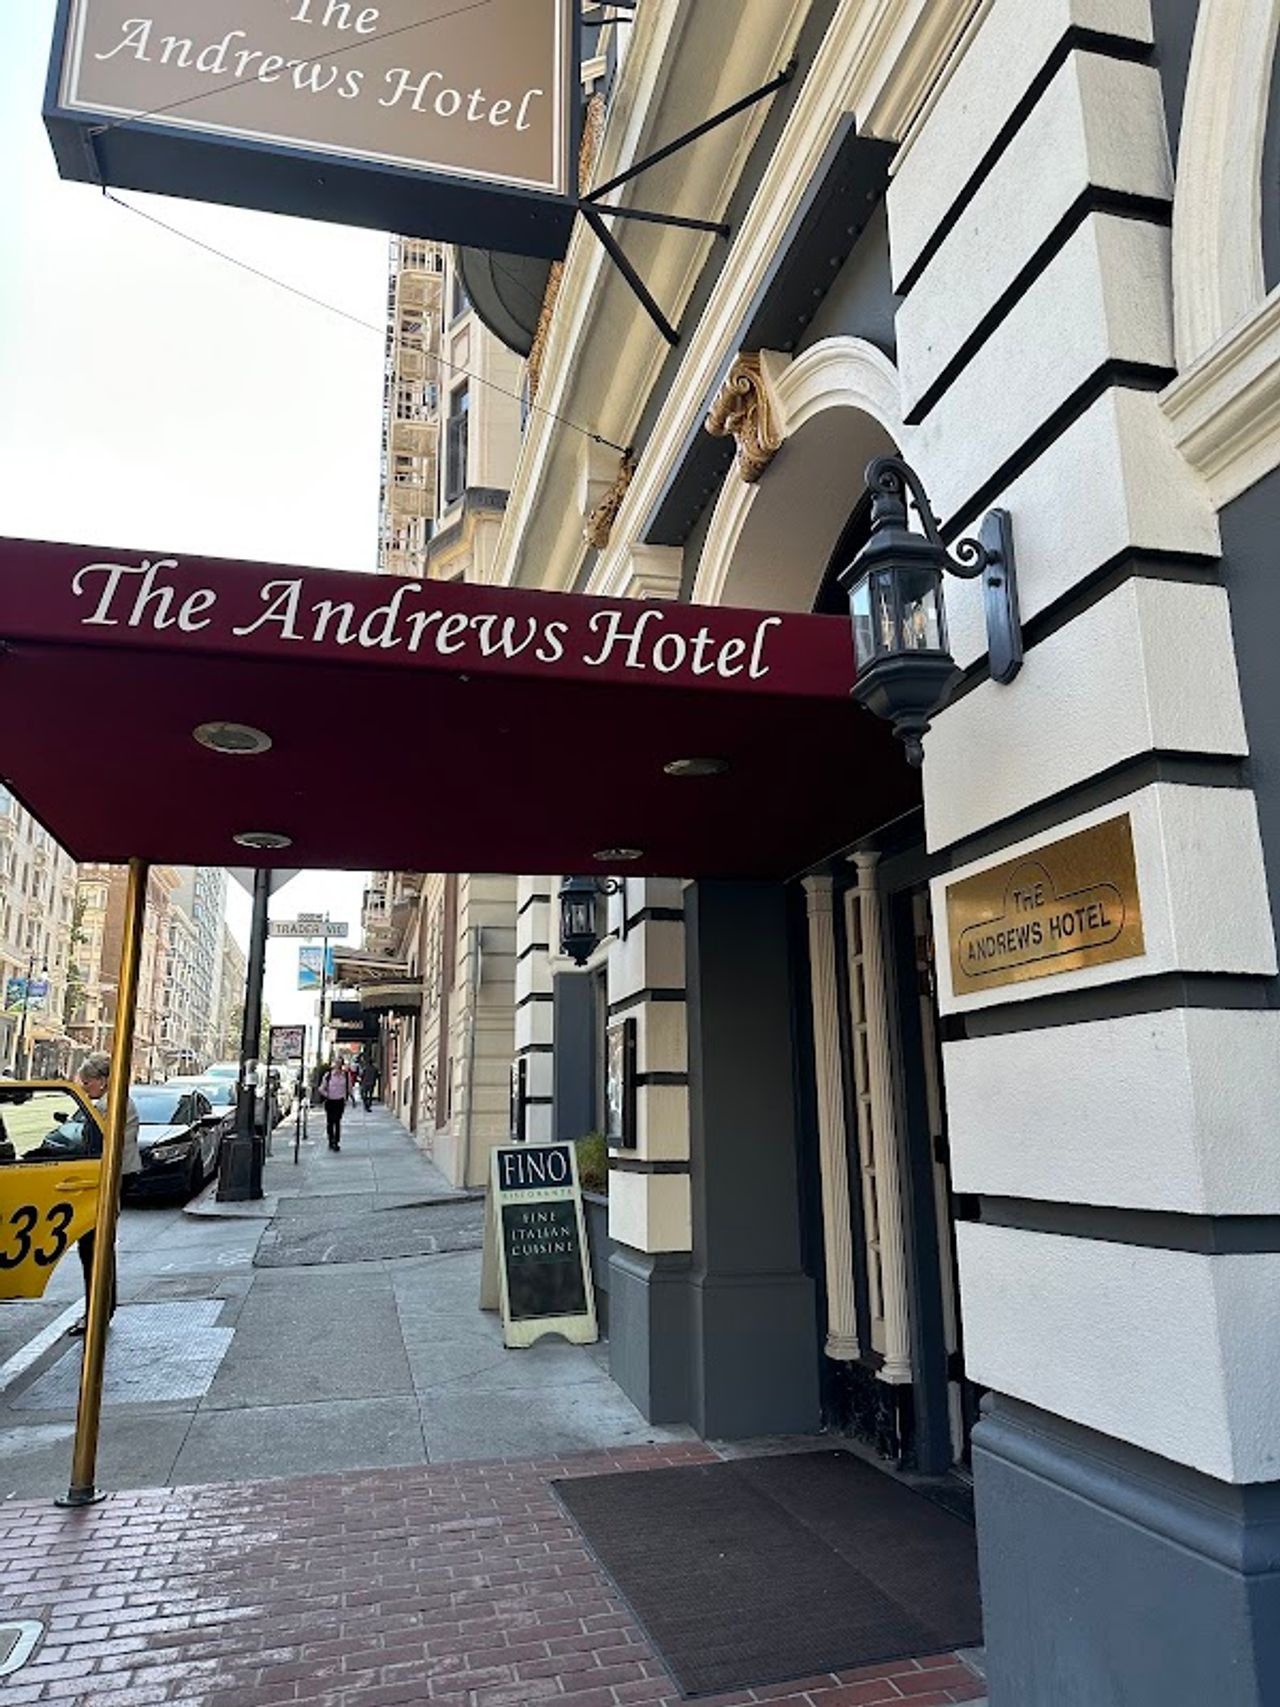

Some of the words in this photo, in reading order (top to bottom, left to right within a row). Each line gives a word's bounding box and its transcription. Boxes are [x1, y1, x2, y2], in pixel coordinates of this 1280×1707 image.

[95, 18, 364, 98] Andrews
[378, 68, 543, 131] Hotel
[71, 558, 217, 632] The
[232, 577, 568, 663] Andrews
[582, 609, 782, 679] Hotel
[1013, 883, 1045, 914] THE
[275, 923, 320, 935] TRADER
[967, 921, 1043, 961] ANDREWS
[1049, 902, 1112, 940] HOTEL
[503, 1150, 567, 1186] FINO
[522, 1211, 556, 1224] FINE
[511, 1226, 570, 1241] ITALIAN
[511, 1241, 573, 1256] CUISINE
